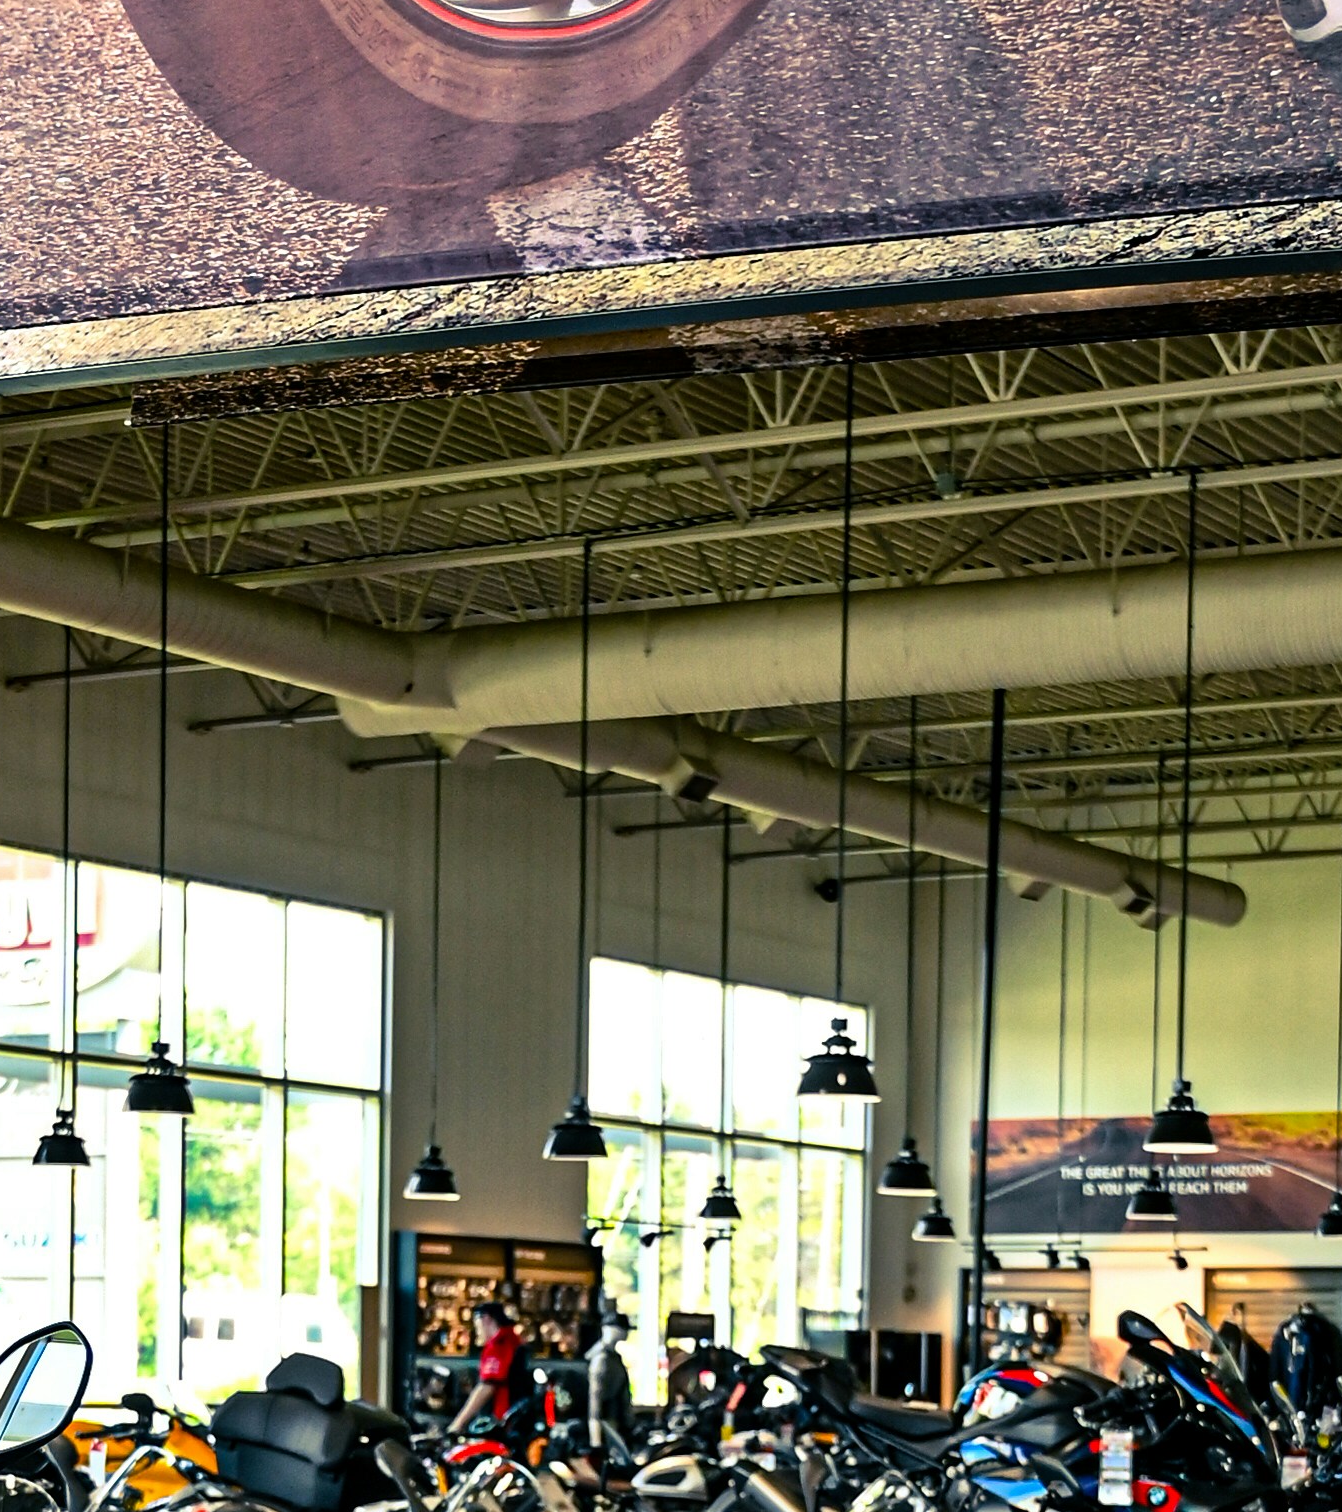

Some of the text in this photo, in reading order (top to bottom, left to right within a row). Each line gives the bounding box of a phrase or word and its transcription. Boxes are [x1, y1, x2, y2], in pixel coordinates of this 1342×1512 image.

[1061, 1167, 1083, 1180] THE
[1086, 1166, 1124, 1180] GREAT
[1167, 1165, 1207, 1179] ABOUT
[1211, 1164, 1273, 1178] HORIZONS
[1082, 1182, 1095, 1196] IS
[1097, 1182, 1123, 1196] YOU
[1168, 1180, 1209, 1194] REACH
[1213, 1179, 1247, 1194] THEM
